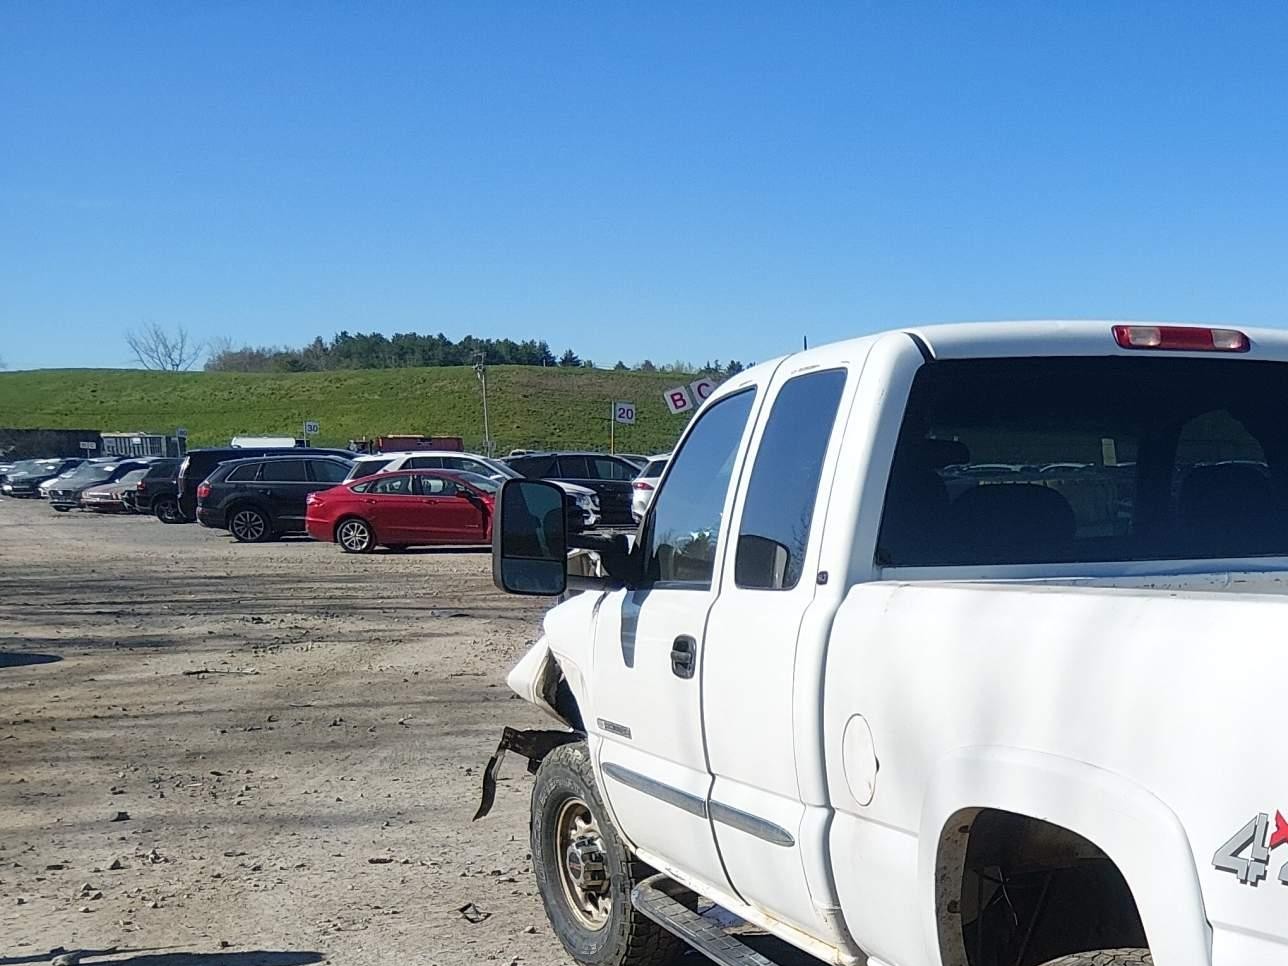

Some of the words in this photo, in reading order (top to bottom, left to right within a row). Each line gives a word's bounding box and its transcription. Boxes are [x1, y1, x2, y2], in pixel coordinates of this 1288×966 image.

[670, 392, 687, 410] B
[618, 408, 634, 419] 20
[307, 424, 318, 433] 30
